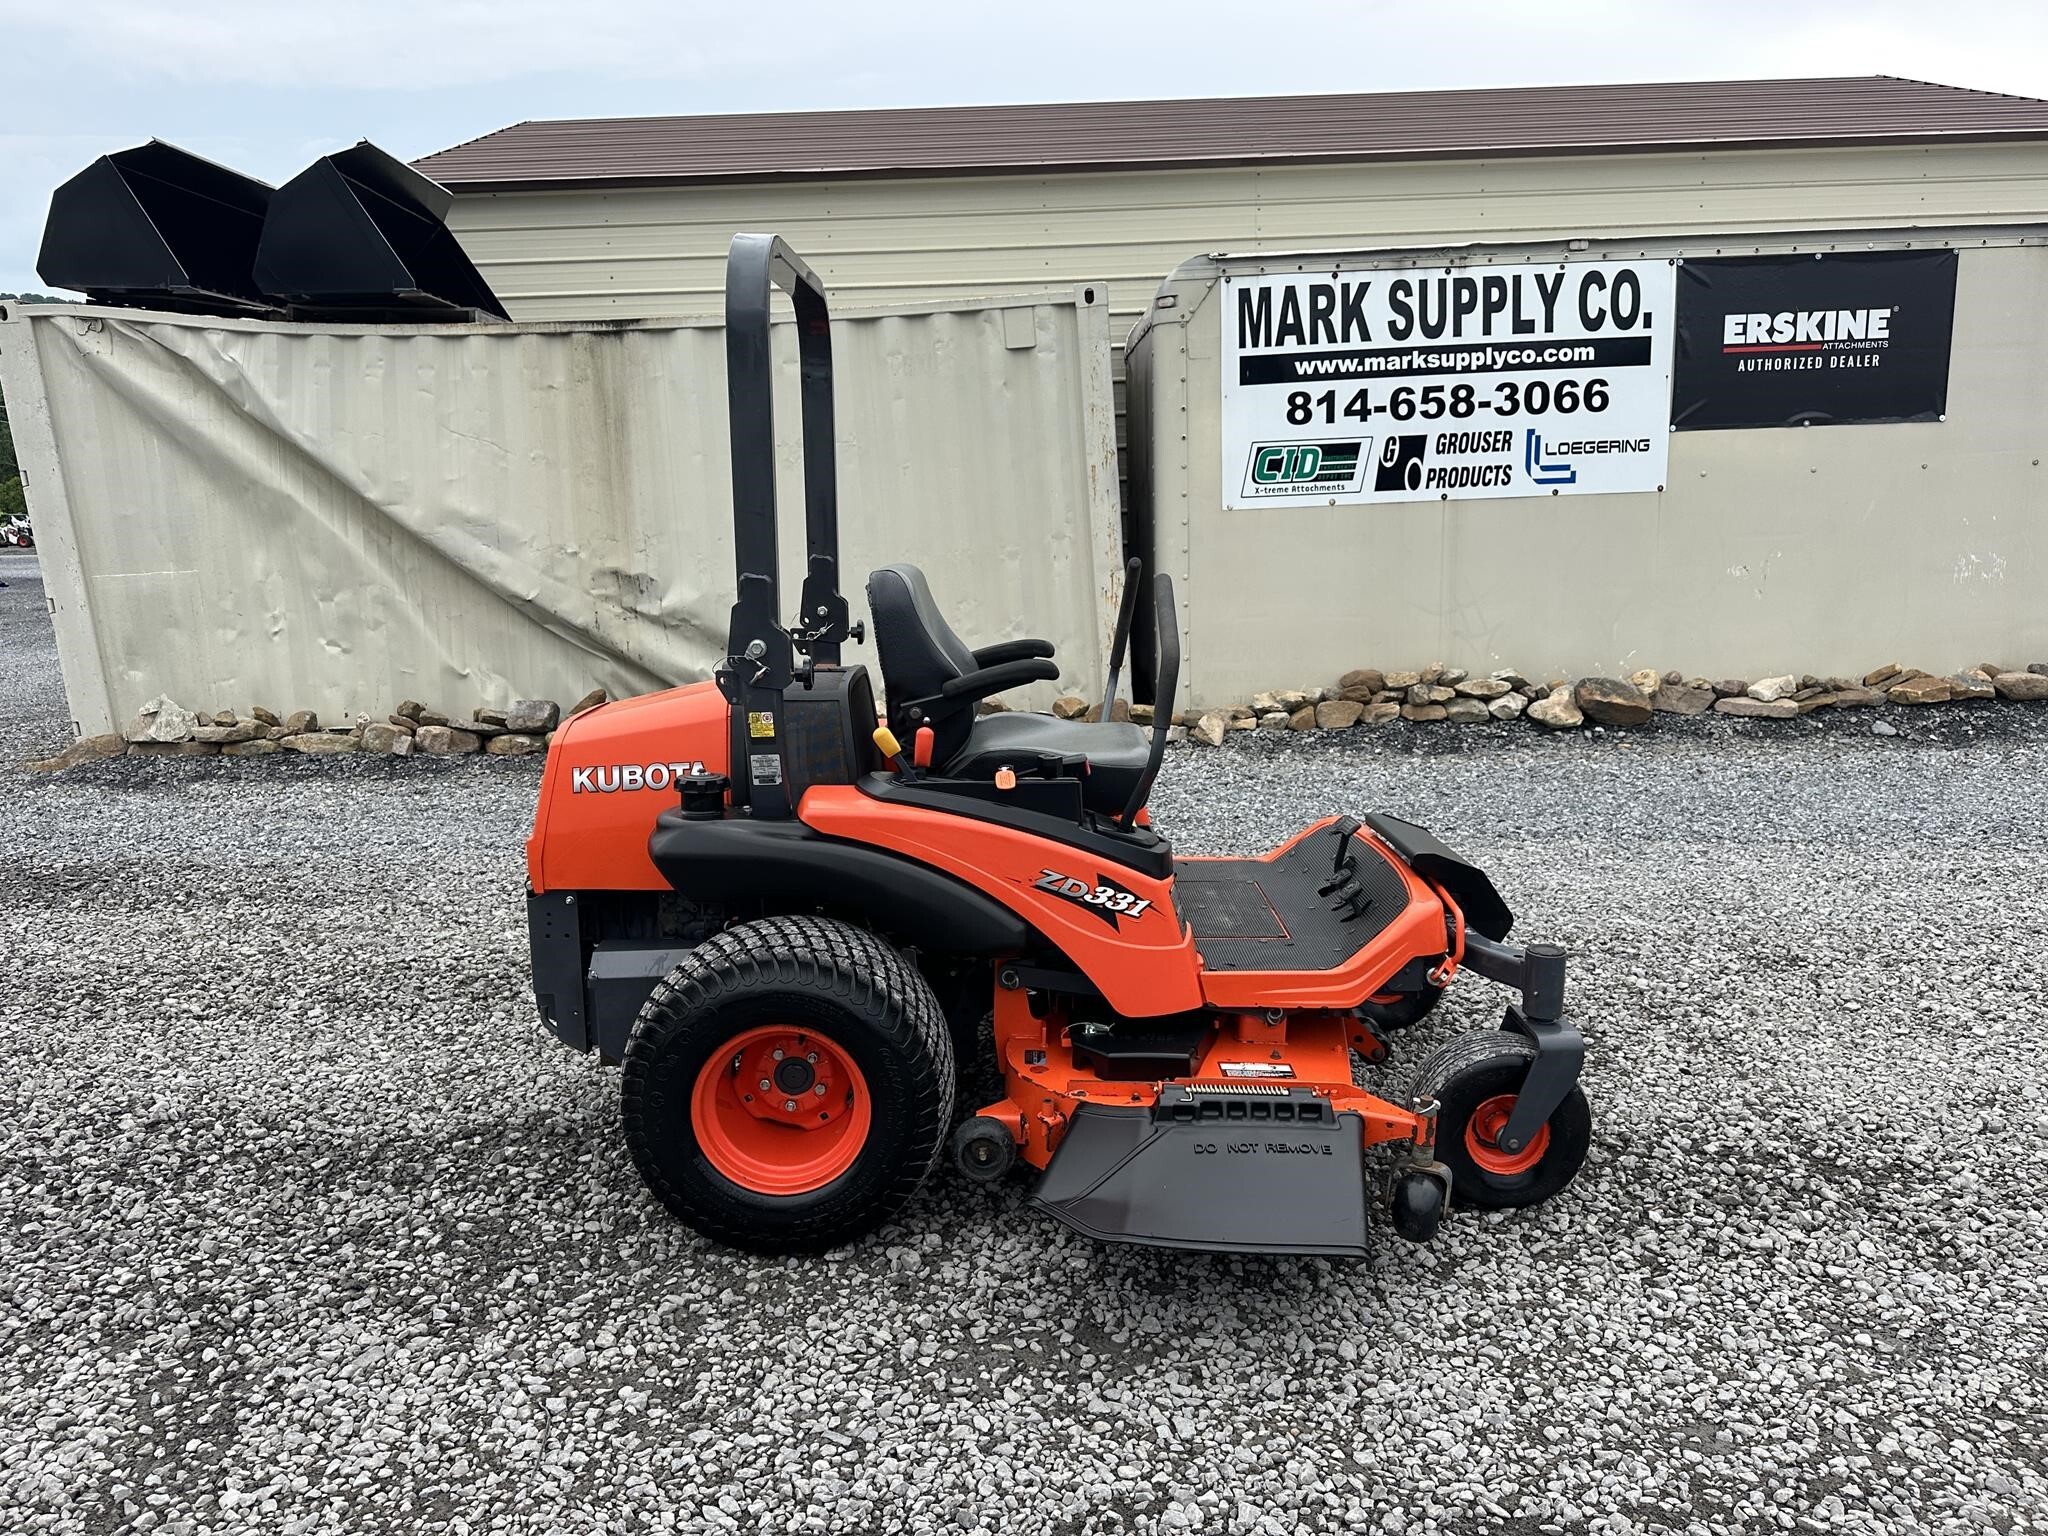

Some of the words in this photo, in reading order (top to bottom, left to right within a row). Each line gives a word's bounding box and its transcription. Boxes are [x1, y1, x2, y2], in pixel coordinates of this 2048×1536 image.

[1238, 281, 1372, 349] MARK
[1387, 273, 1565, 343] SUPPLY
[1578, 268, 1653, 333] CO.
[1724, 309, 1891, 344] ERSKINE
[1822, 340, 1889, 350] ATTACHMENTS
[1295, 346, 1595, 376] www.marksupplyco.com
[1738, 357, 1823, 372] AUTHORIZED
[1830, 355, 1880, 368] DEALER
[1286, 378, 1610, 426] 814-658-3066
[1436, 431, 1512, 455] GROUSER
[1545, 439, 1650, 455] LOEGERING
[1255, 446, 1322, 483] CID
[1425, 464, 1512, 489] PRODUCTS
[1254, 487, 1289, 495] X-treme
[1291, 484, 1345, 493] Attachments
[1035, 868, 1152, 917] ZD331
[1193, 1143, 1217, 1154] DO
[1227, 1143, 1258, 1154] NOT
[1265, 1143, 1332, 1155] REMOVE
